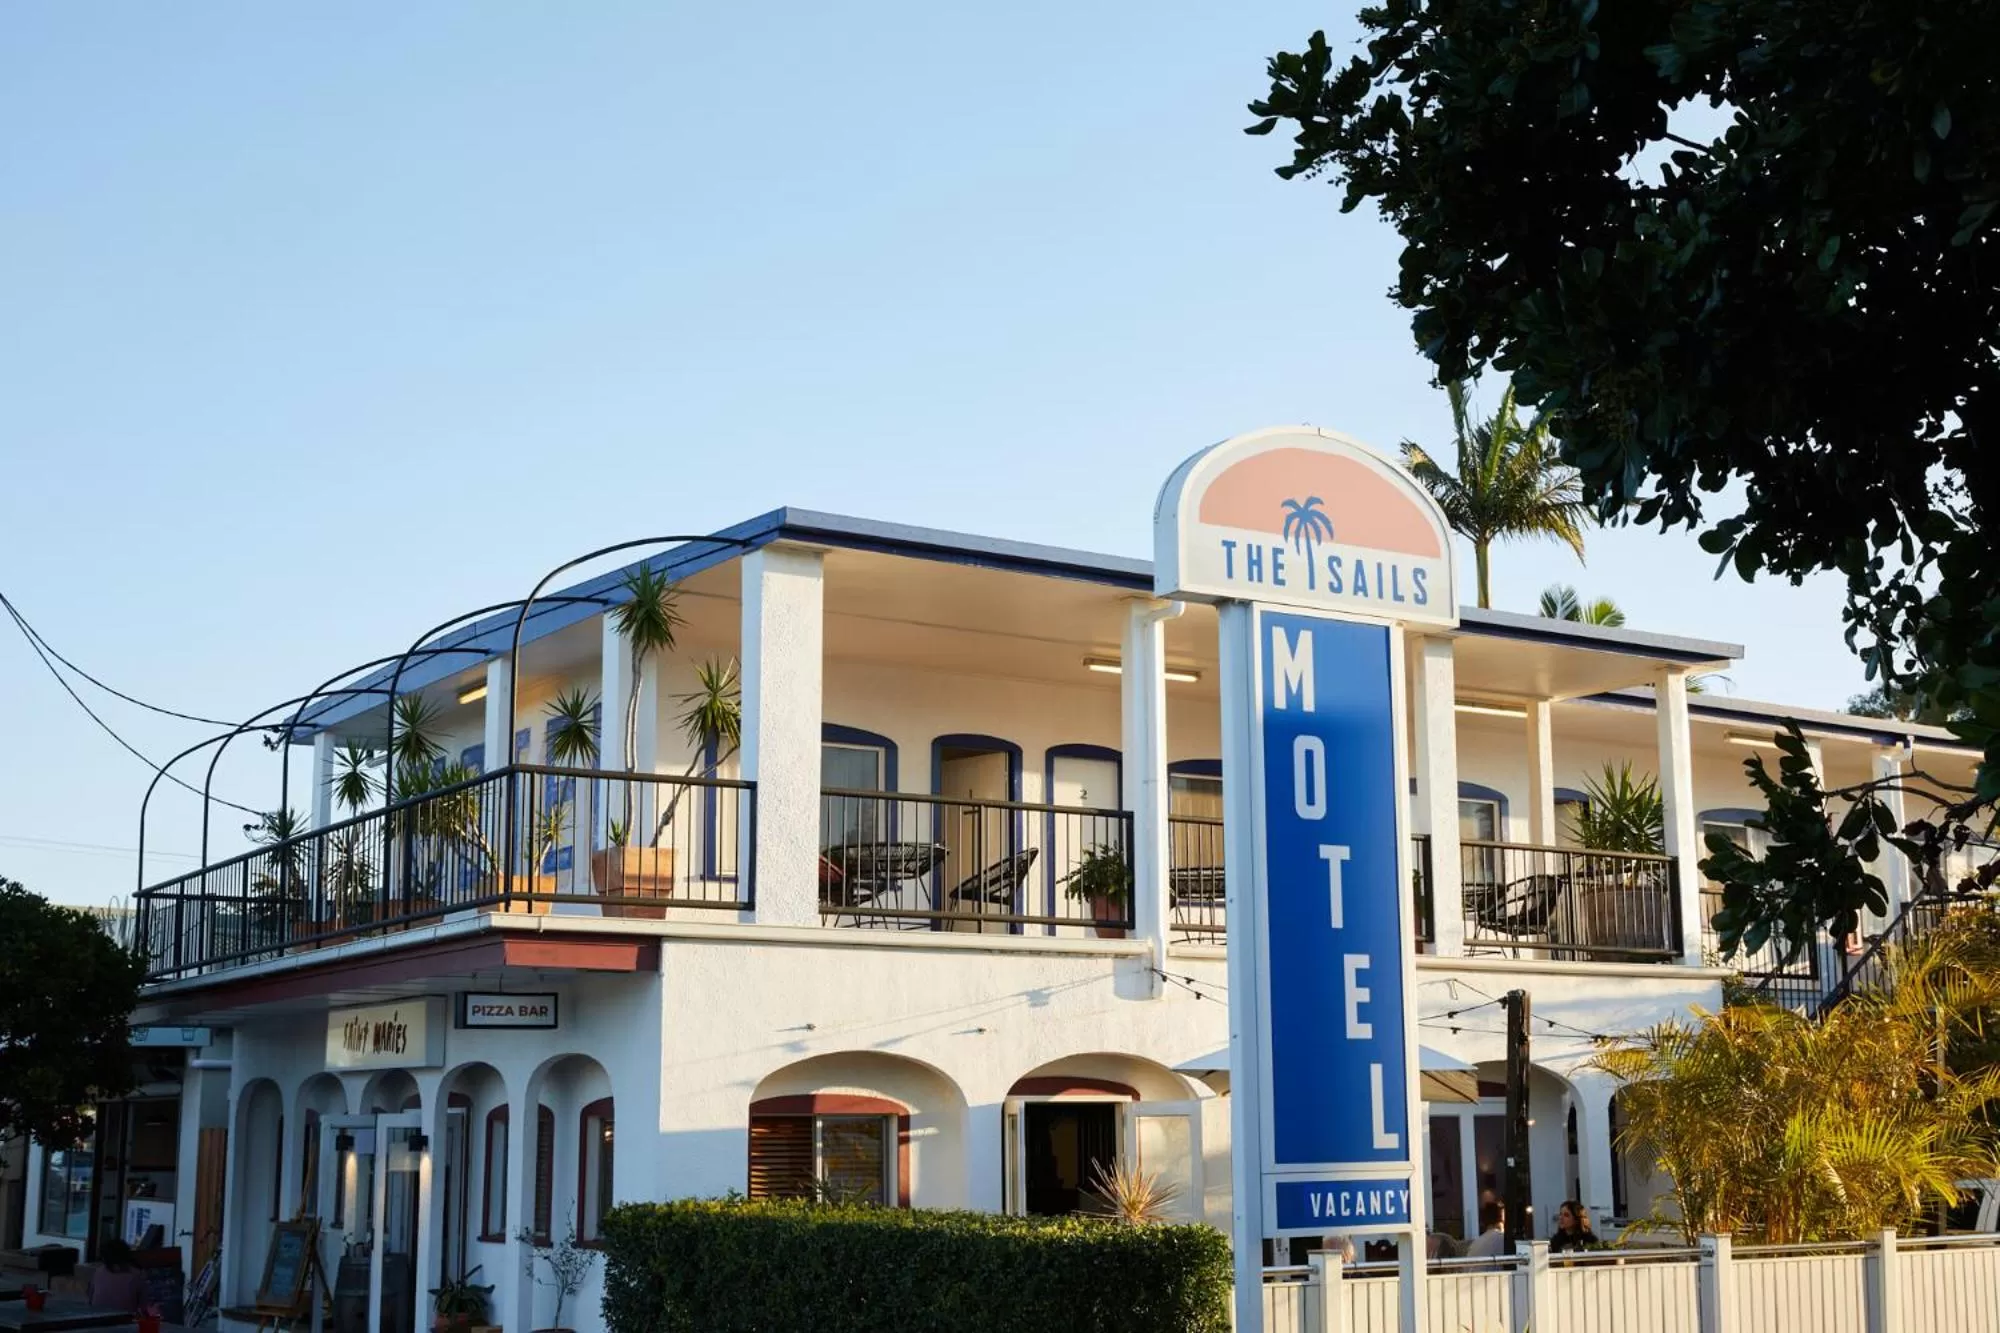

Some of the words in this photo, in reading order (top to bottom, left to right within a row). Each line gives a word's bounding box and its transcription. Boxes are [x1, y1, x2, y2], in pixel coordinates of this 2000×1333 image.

[1221, 539, 1286, 586] THE
[1328, 555, 1428, 605] SAILS
[1079, 789, 1088, 800] 2
[1271, 626, 1399, 1149] MOTEL
[471, 1005, 514, 1016] PIZZA
[518, 1005, 549, 1016] BAR
[1310, 1190, 1409, 1218] VACANCY
